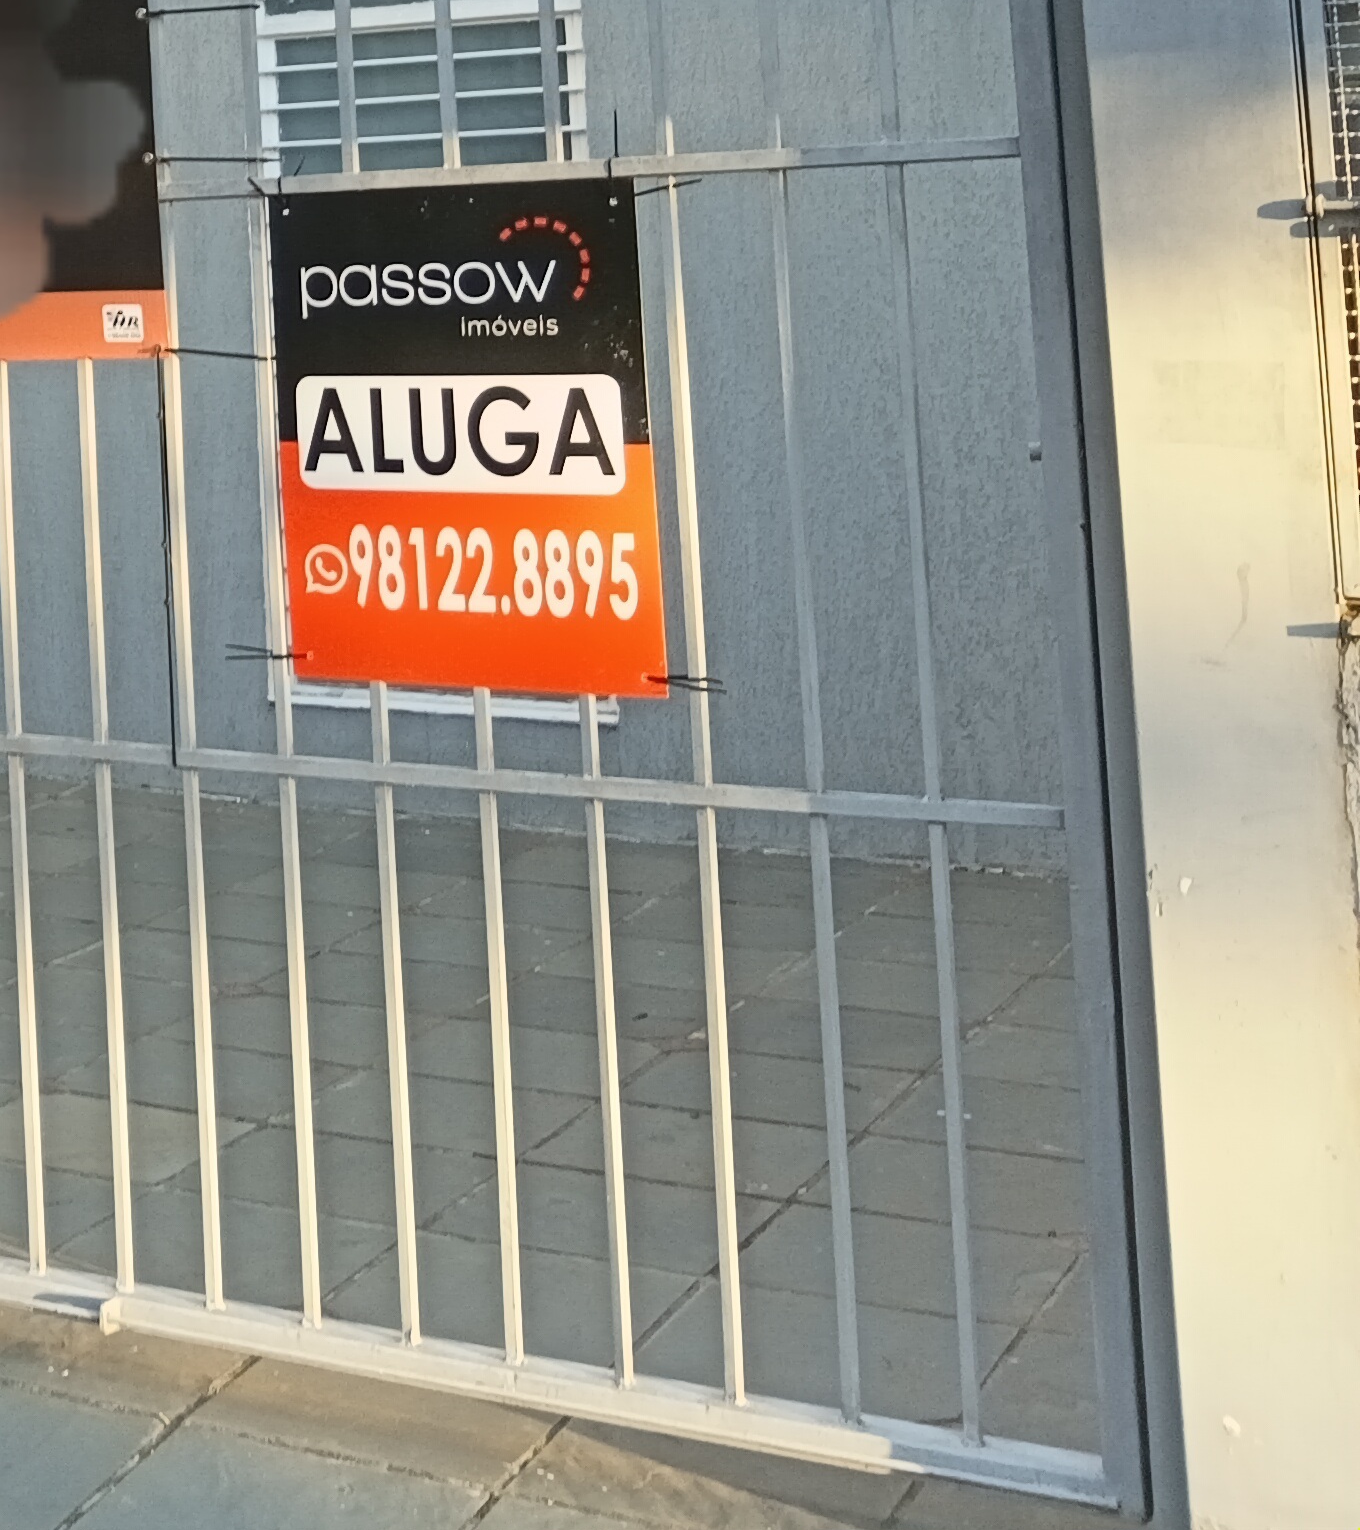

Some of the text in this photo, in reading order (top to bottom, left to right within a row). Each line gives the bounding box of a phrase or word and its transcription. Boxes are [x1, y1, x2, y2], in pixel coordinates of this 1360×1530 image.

[301, 259, 557, 320] passow
[460, 314, 560, 337] imóveis
[303, 385, 617, 477] ALUGA
[348, 523, 639, 621] 98122.8895
